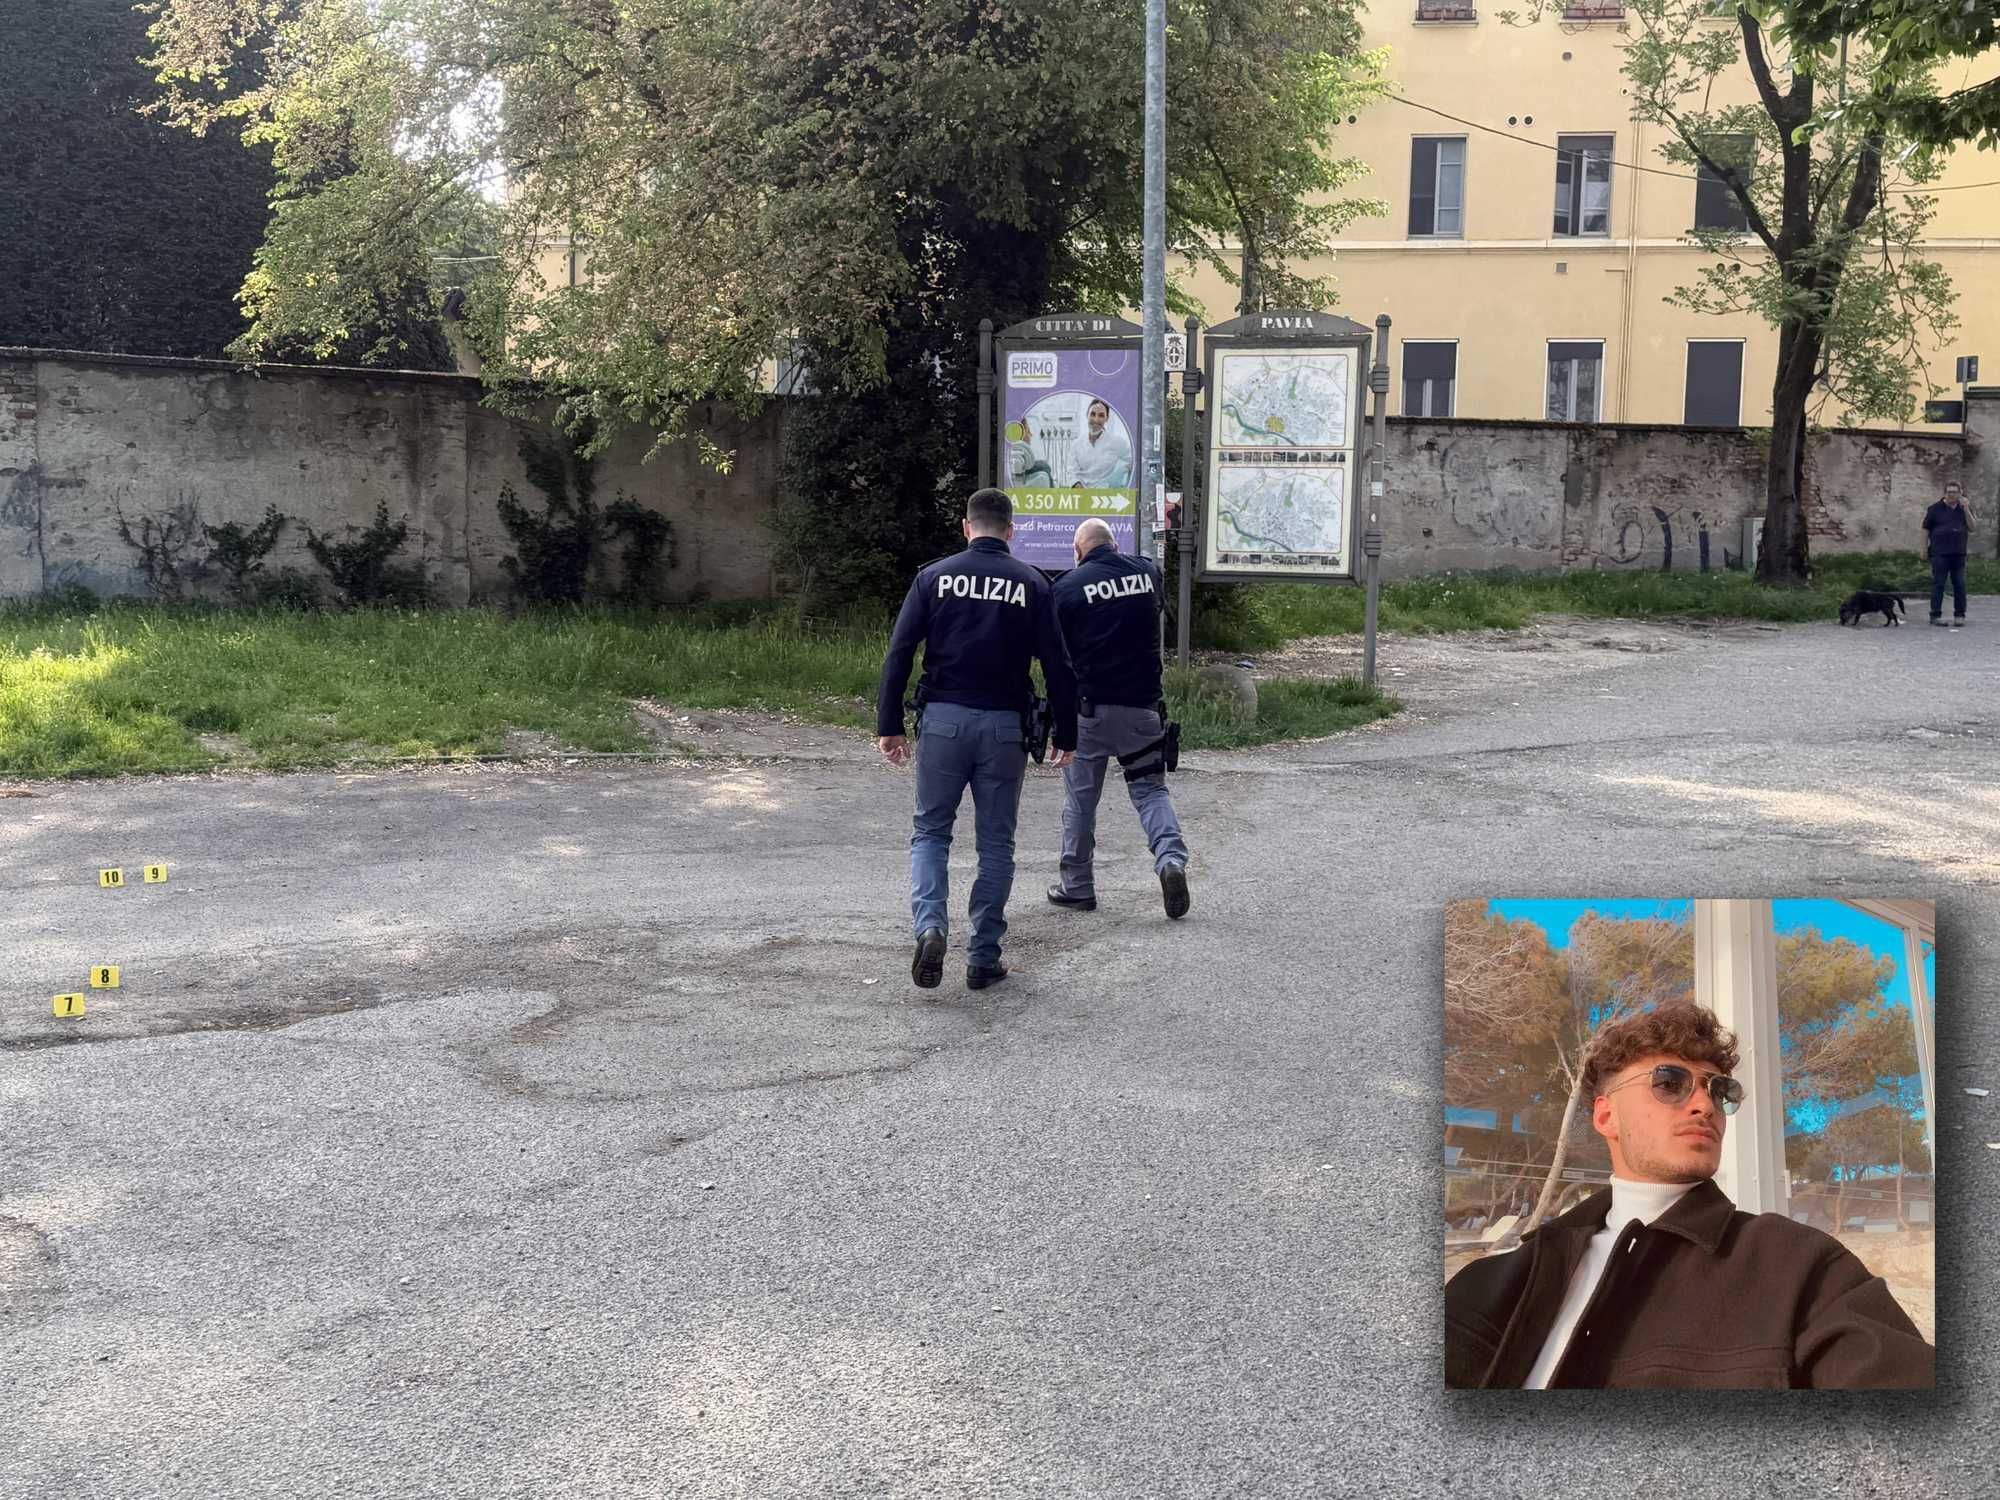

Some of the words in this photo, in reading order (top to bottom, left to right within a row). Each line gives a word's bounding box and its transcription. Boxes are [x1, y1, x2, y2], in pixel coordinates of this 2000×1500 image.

[1035, 319, 1087, 332] CITTA'
[1092, 319, 1112, 331] DI
[1261, 316, 1314, 329] PAVIA
[1012, 361, 1054, 375] PRIMO
[1011, 494, 1020, 509] A
[1025, 494, 1054, 510] 350
[1058, 494, 1081, 510] MT
[1037, 521, 1076, 532] Petrarca
[1110, 522, 1134, 533] AVIA
[938, 574, 1026, 608] POLIZIA
[1083, 573, 1154, 604] POLIZIA
[104, 871, 119, 884] 10
[151, 867, 159, 879] 9
[101, 968, 110, 984] 8
[63, 996, 73, 1012] 7
